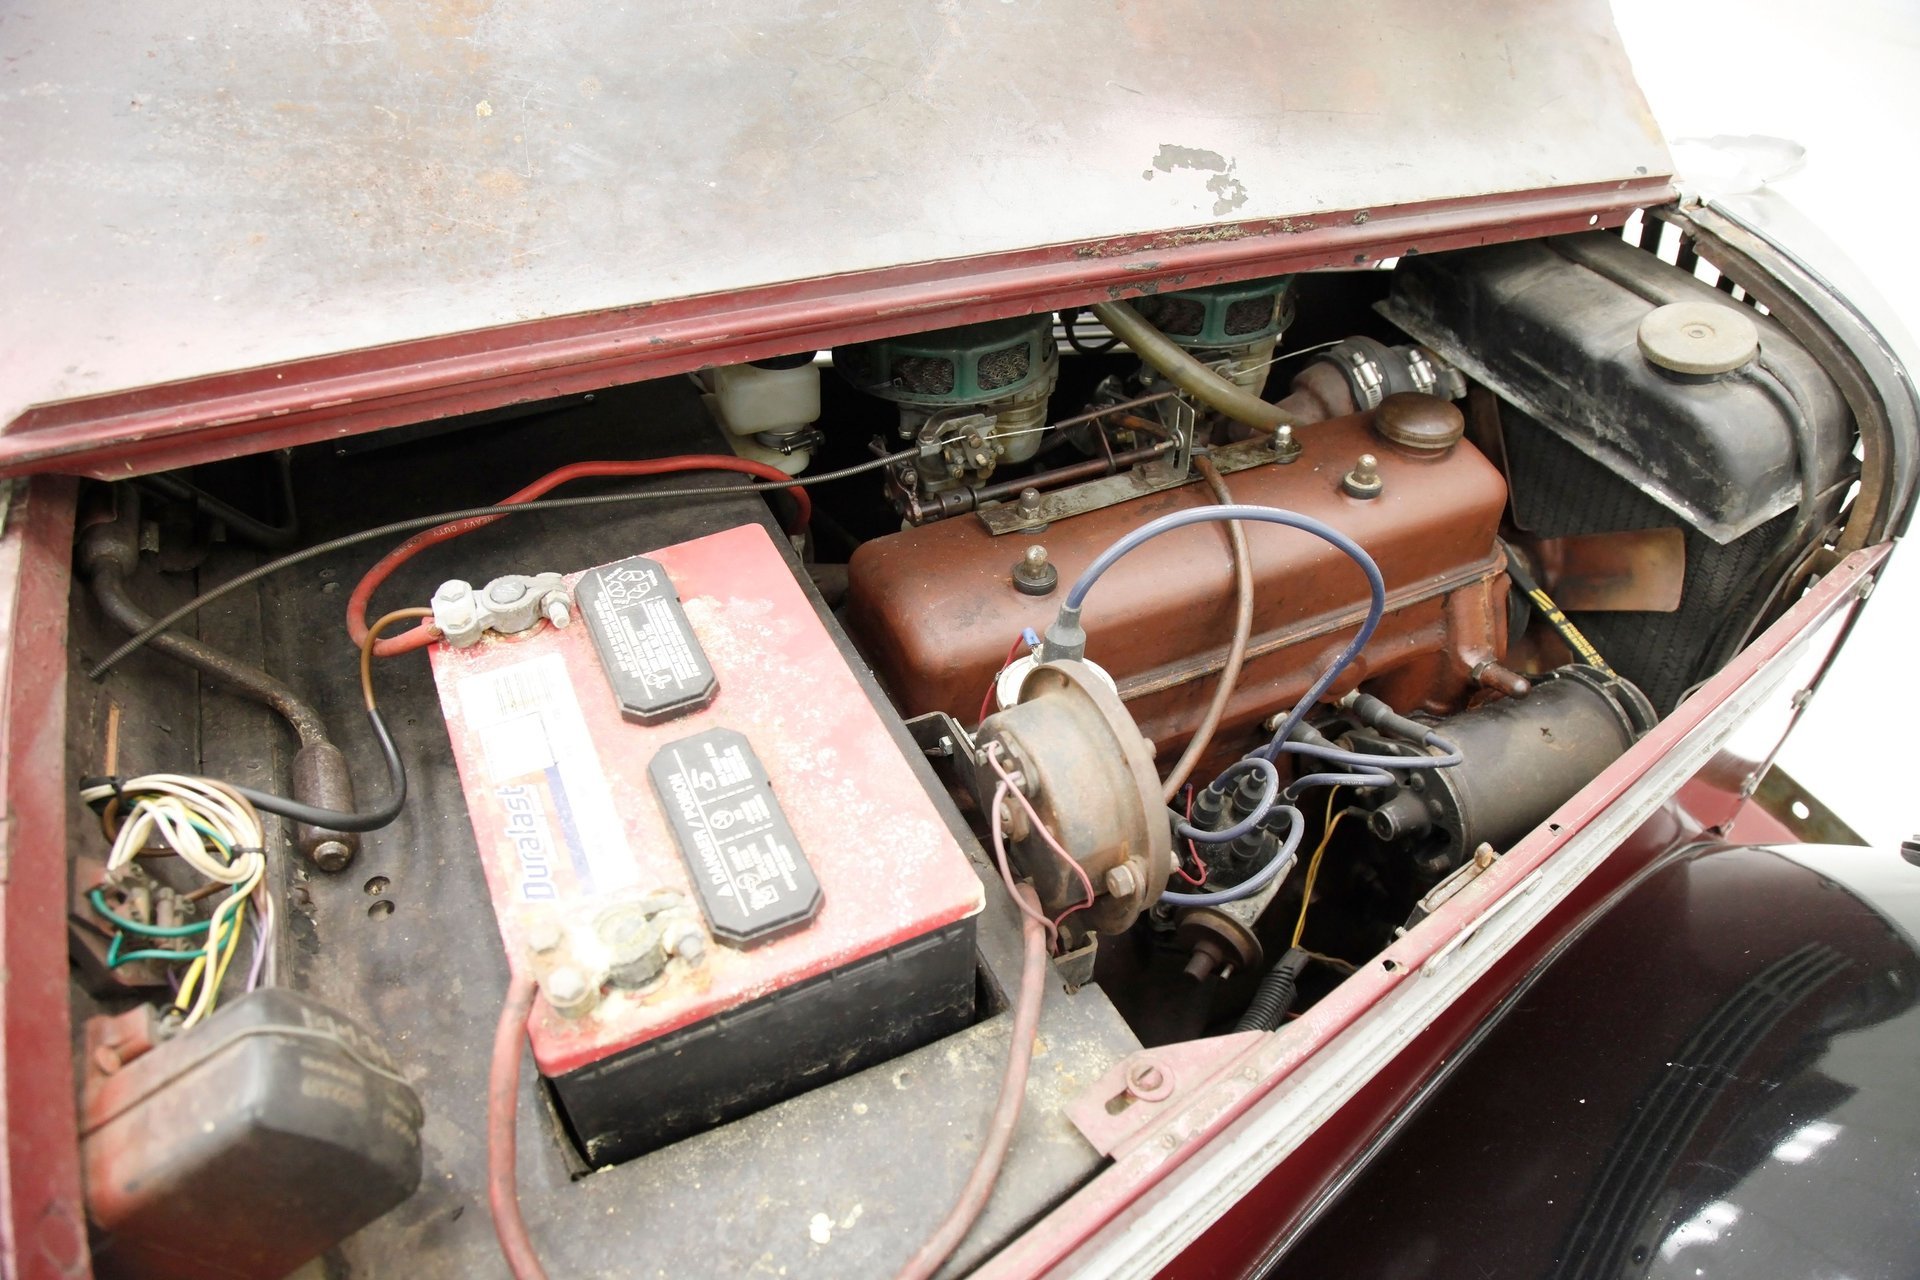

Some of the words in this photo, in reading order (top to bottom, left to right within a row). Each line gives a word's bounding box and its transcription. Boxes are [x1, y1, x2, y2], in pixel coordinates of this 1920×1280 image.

[432, 525, 458, 537] DUTY
[464, 514, 494, 529] HEAVY
[668, 772, 699, 820] POISON
[497, 786, 556, 899] Duralast
[693, 829, 728, 885] DANGER
